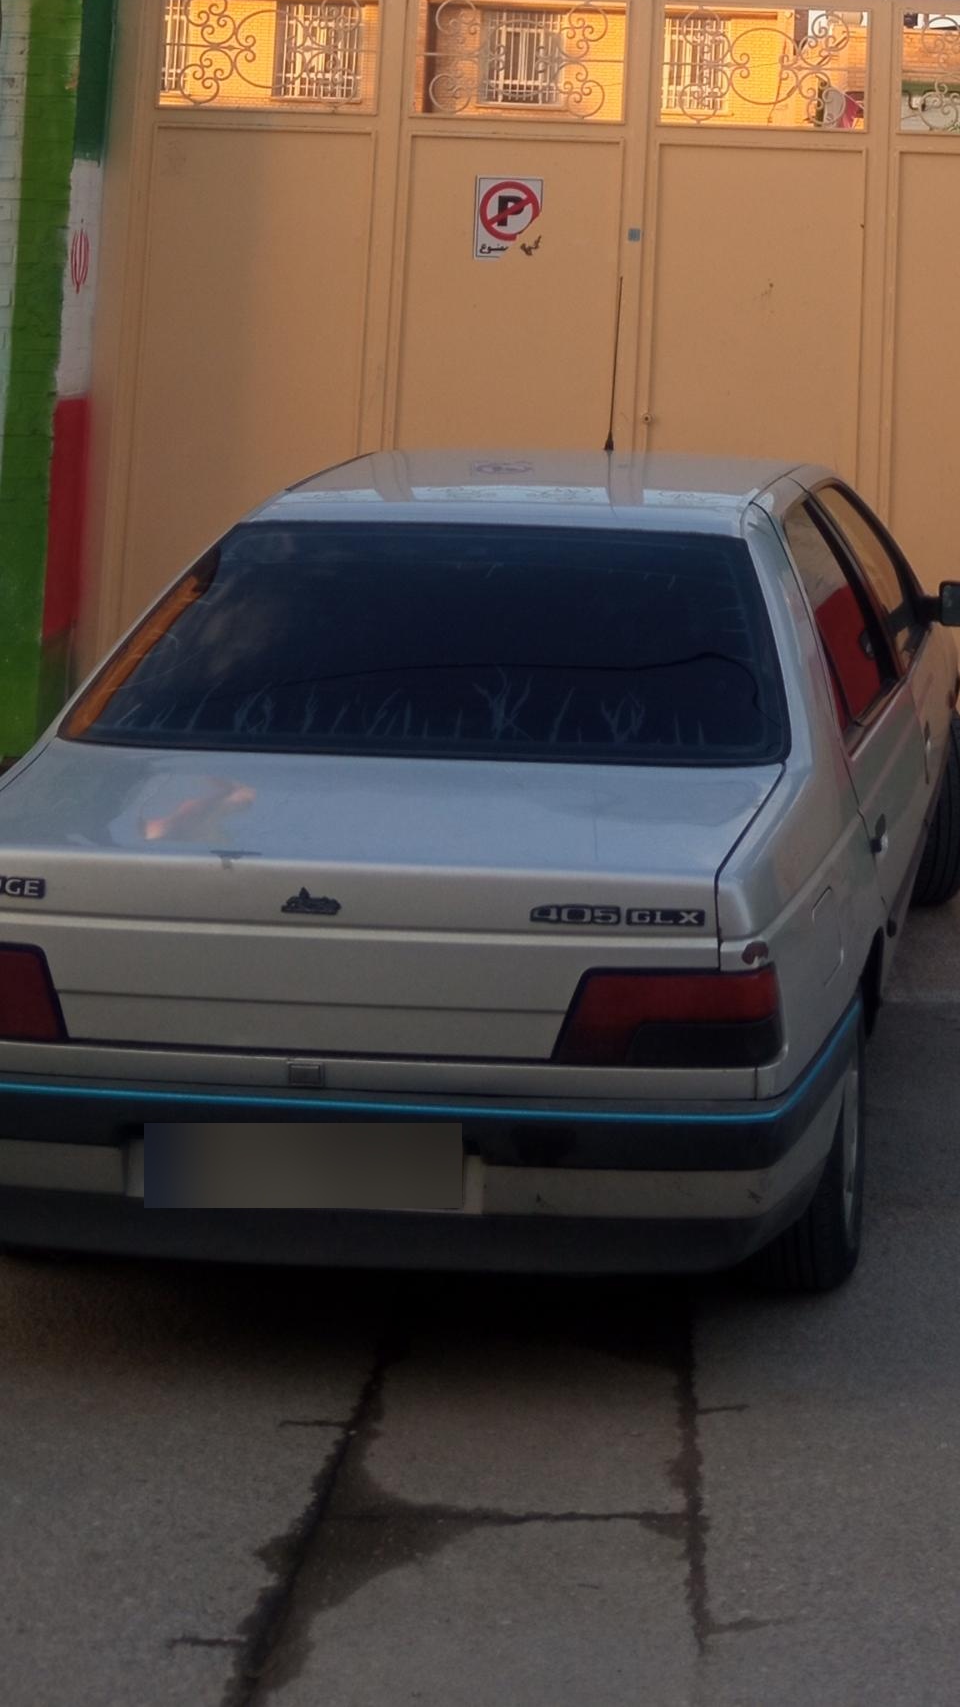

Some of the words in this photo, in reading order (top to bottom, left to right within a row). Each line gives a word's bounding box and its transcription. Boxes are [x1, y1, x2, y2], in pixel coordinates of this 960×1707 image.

[479, 243, 509, 254] منوع
[532, 906, 619, 925] 405
[631, 910, 699, 925] GLX
